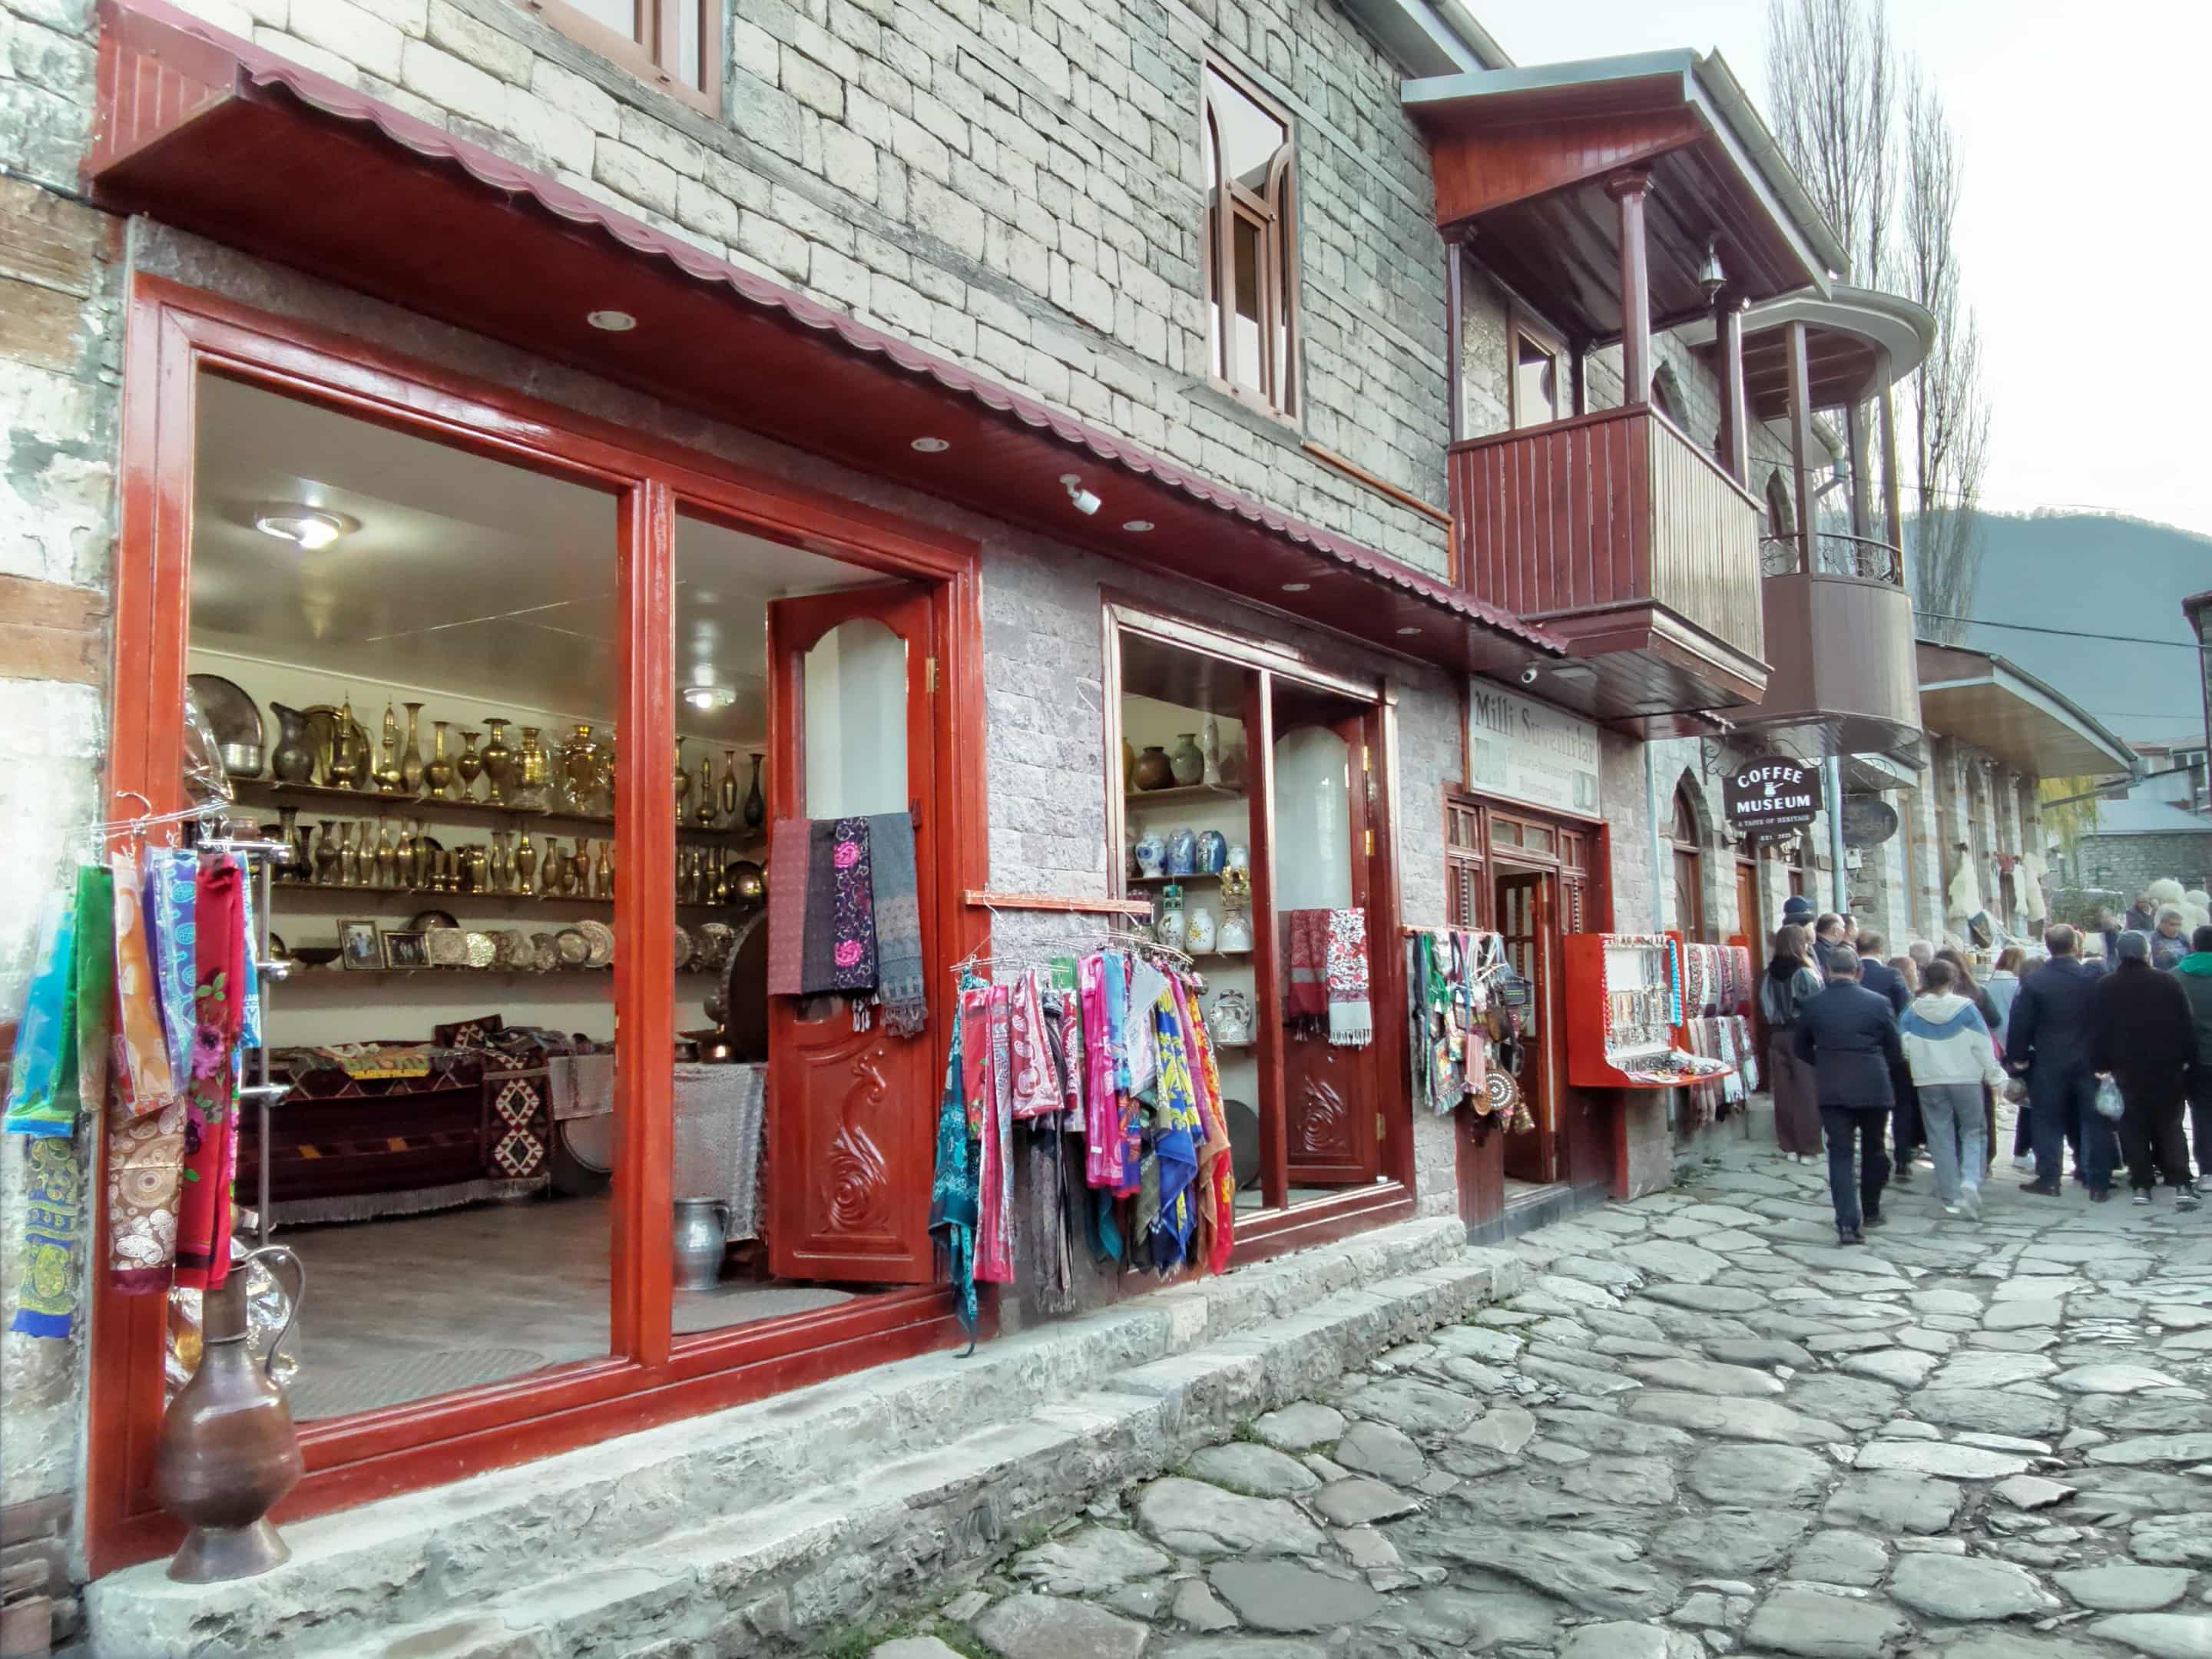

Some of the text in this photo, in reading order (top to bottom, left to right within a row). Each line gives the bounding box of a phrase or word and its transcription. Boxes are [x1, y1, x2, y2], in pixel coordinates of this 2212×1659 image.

[1475, 689, 1514, 738] Milli
[1737, 767, 1803, 788] COFFEE
[1737, 794, 1810, 813] MUSEUM
